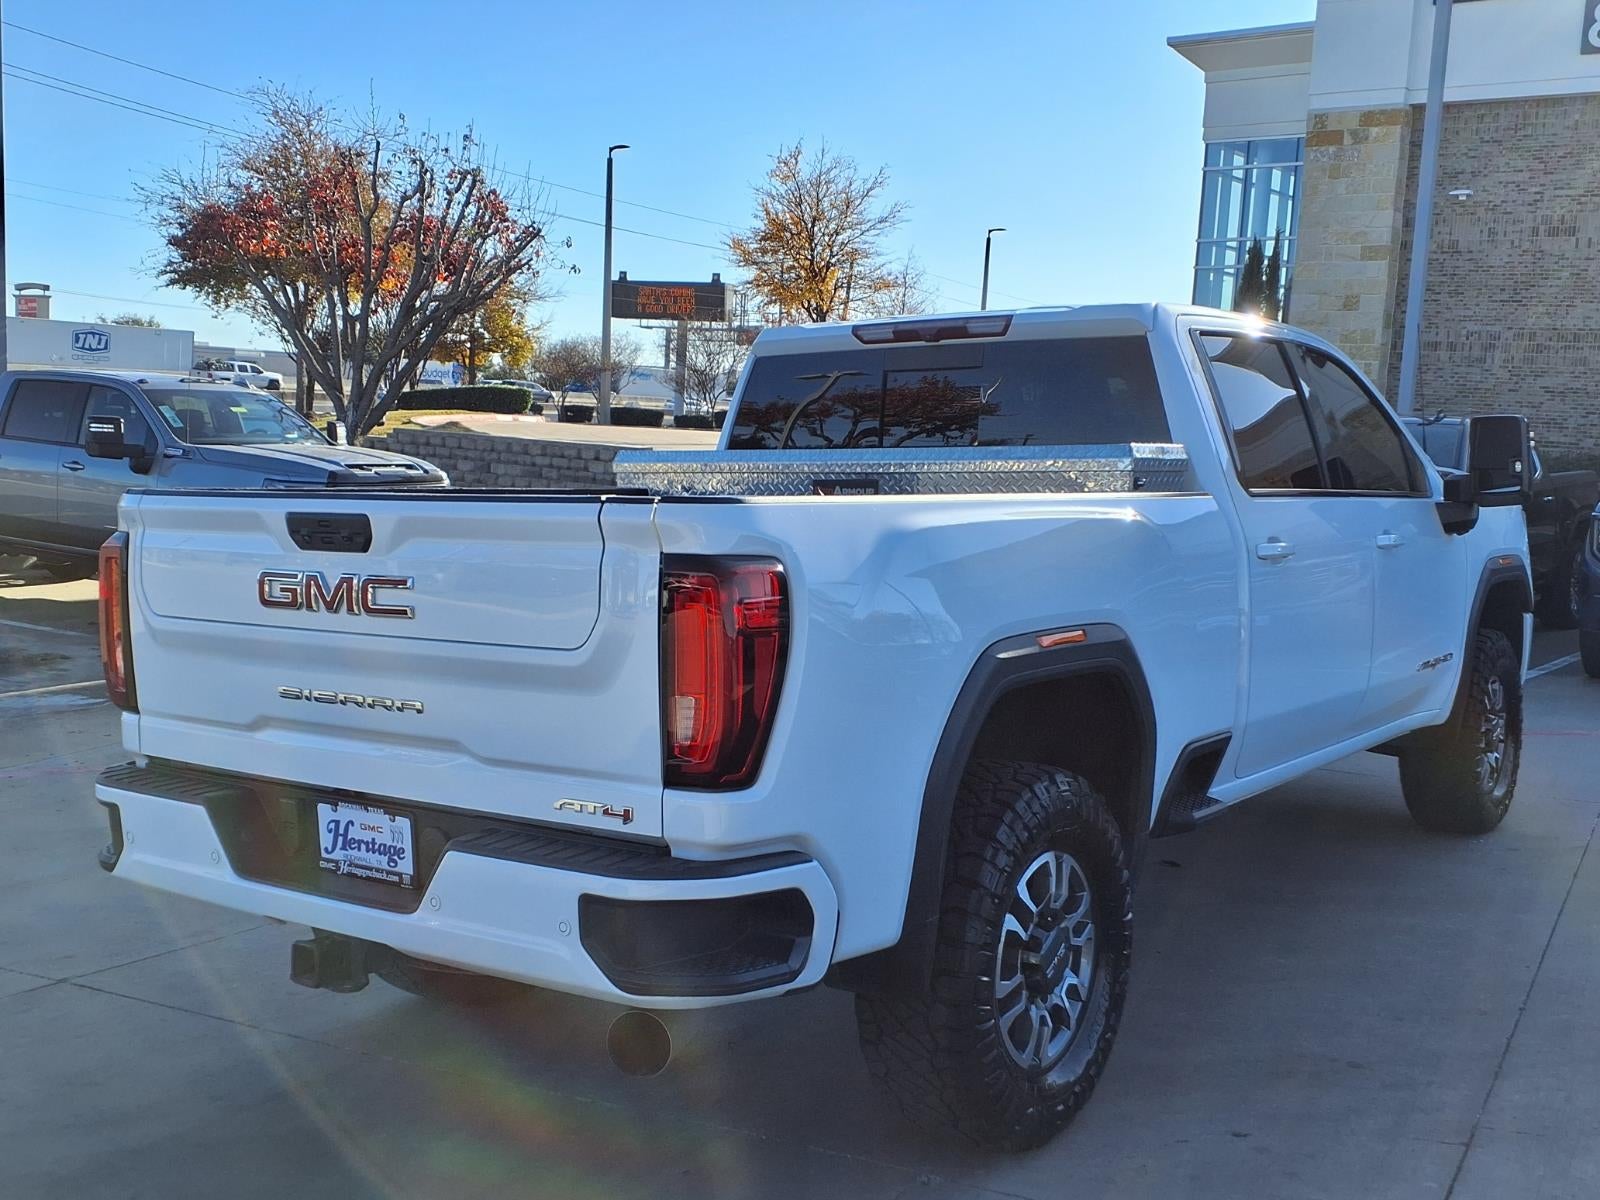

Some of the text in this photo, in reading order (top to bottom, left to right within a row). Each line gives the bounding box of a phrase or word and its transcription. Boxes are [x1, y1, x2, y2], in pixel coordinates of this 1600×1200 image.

[646, 304, 663, 313] GOOD
[660, 296, 674, 305] YOU
[74, 333, 108, 349] JNJ
[257, 569, 416, 620] GMC
[277, 686, 425, 714] SIERRA
[553, 798, 634, 825] AT4
[360, 823, 384, 834] GMC
[323, 819, 406, 868] Heritage
